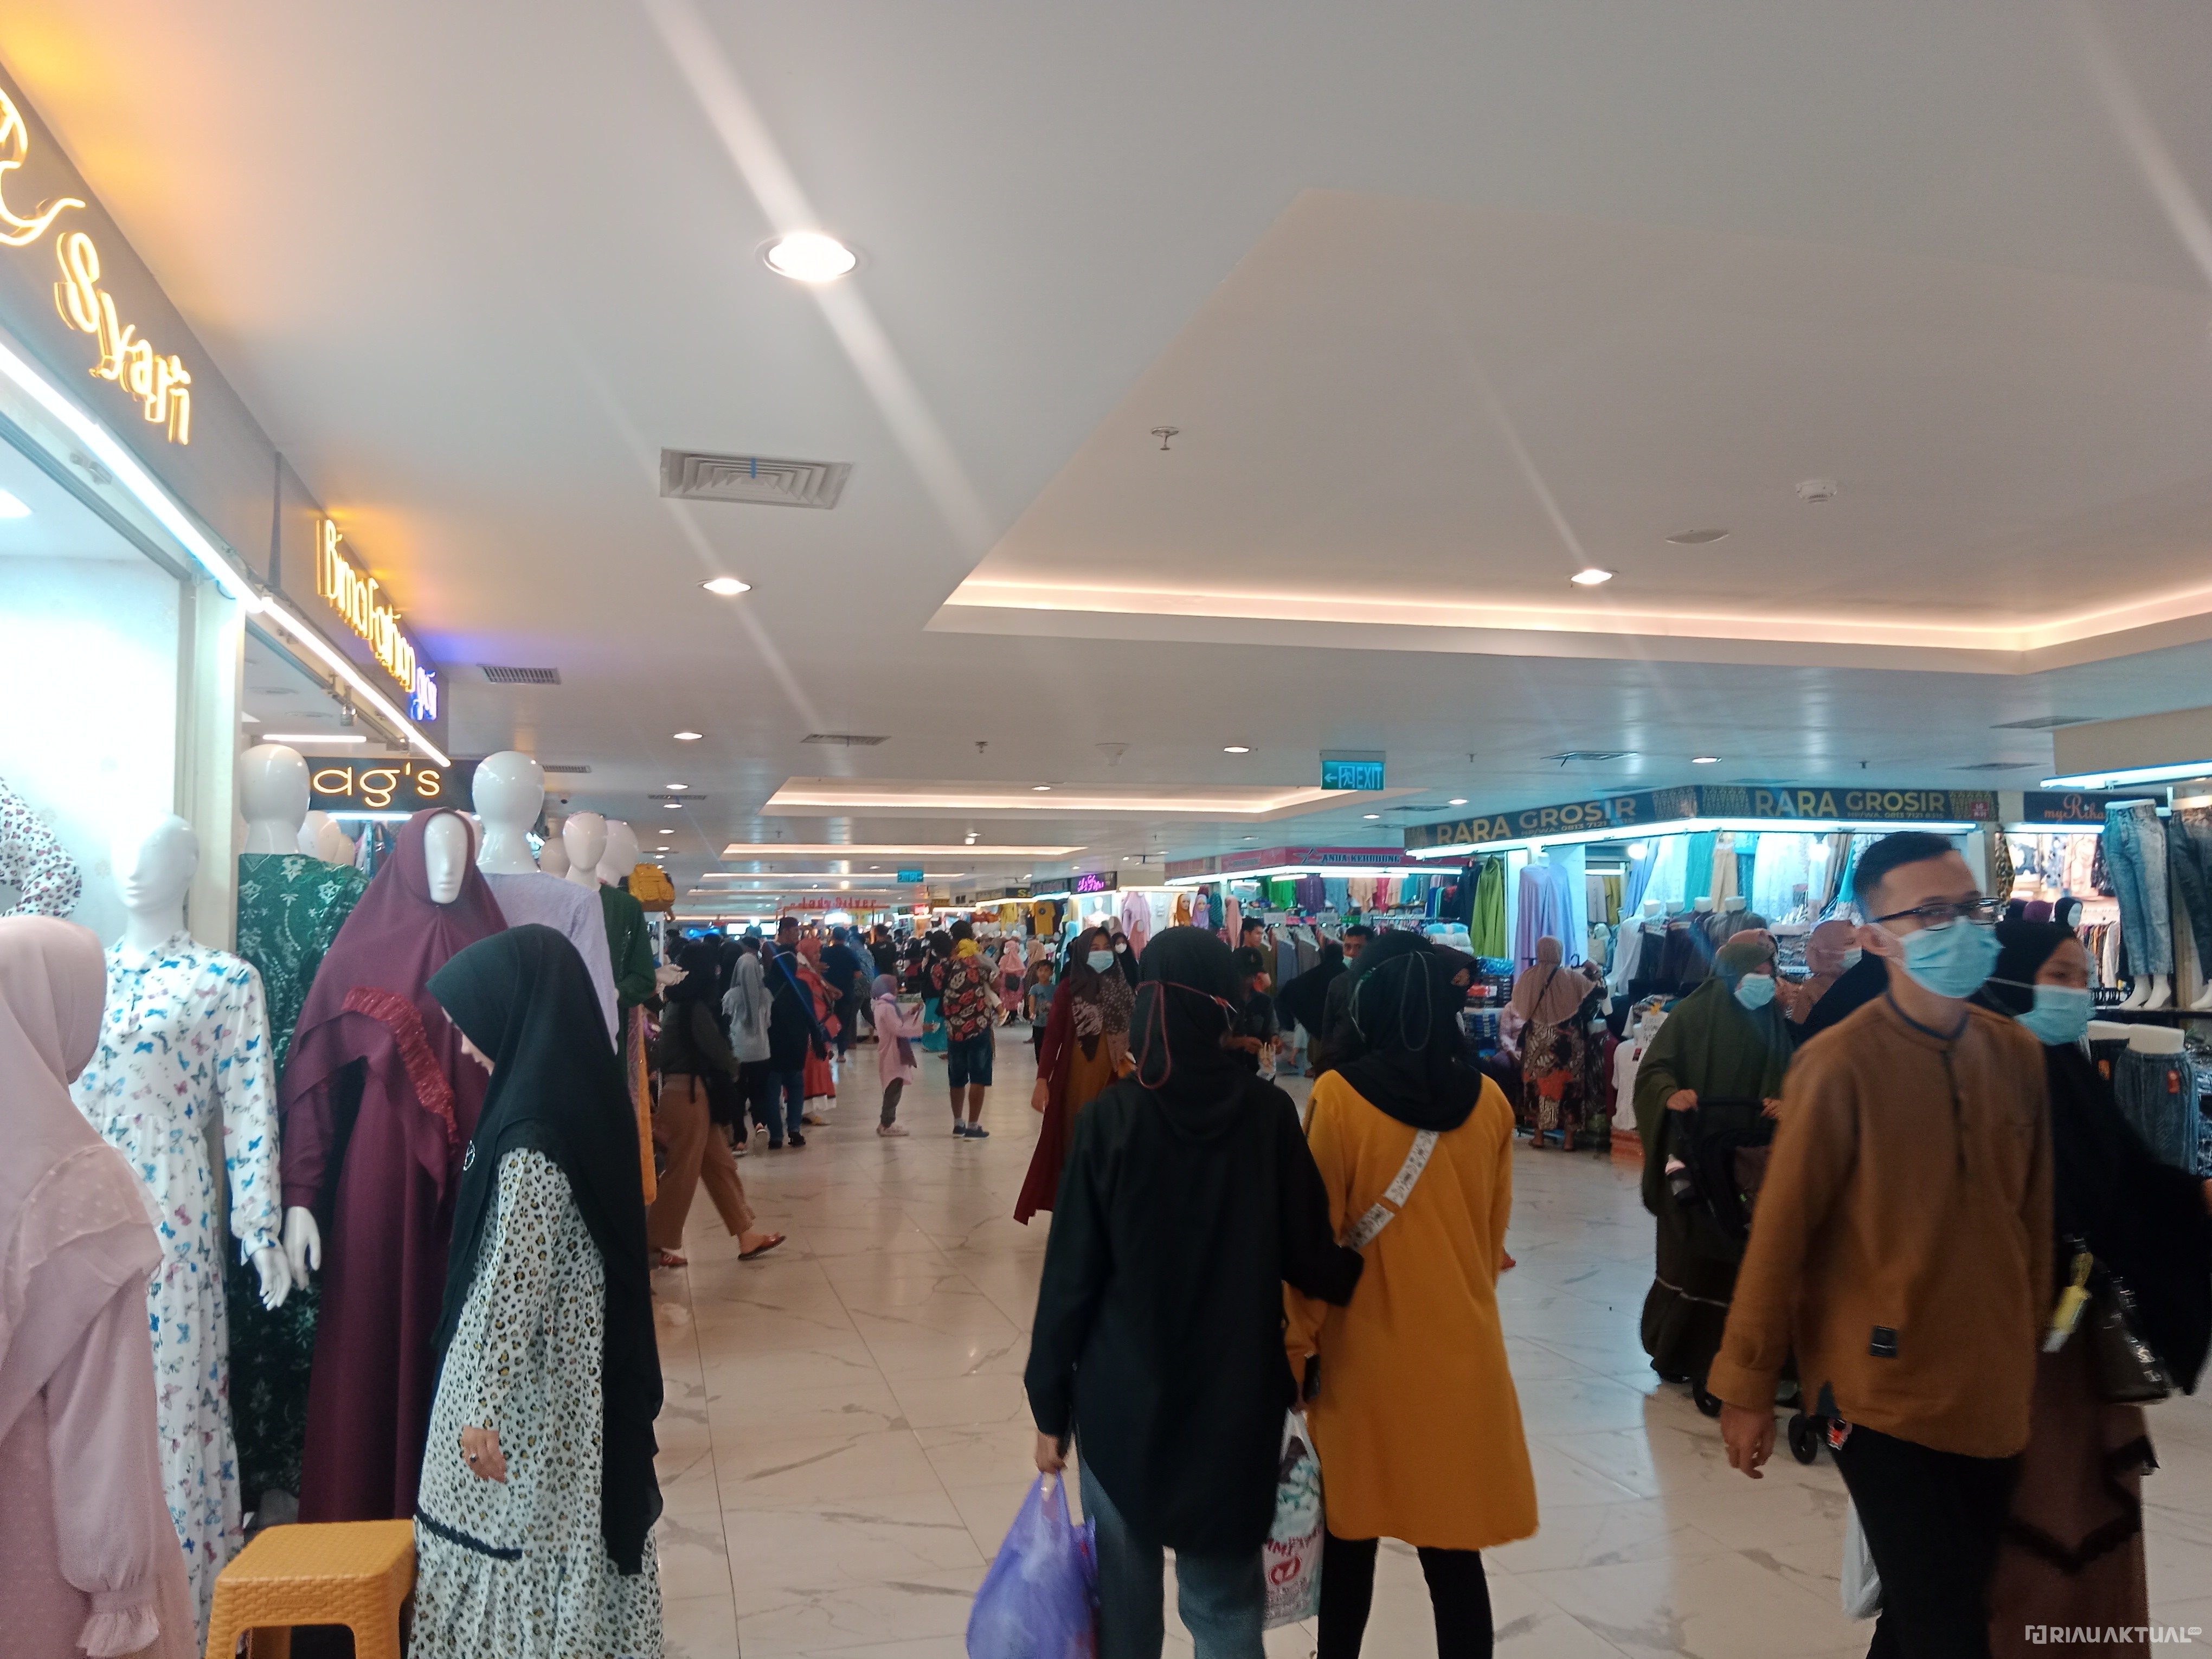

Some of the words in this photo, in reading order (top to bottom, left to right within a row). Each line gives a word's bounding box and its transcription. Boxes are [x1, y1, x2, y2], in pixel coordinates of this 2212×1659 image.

[1356, 766, 1383, 789] EXIT
[1755, 789, 1838, 818] RARA
[1846, 791, 1945, 812] GROSIR
[1437, 815, 1512, 845] RARA
[1519, 798, 1636, 830] GROSIR
